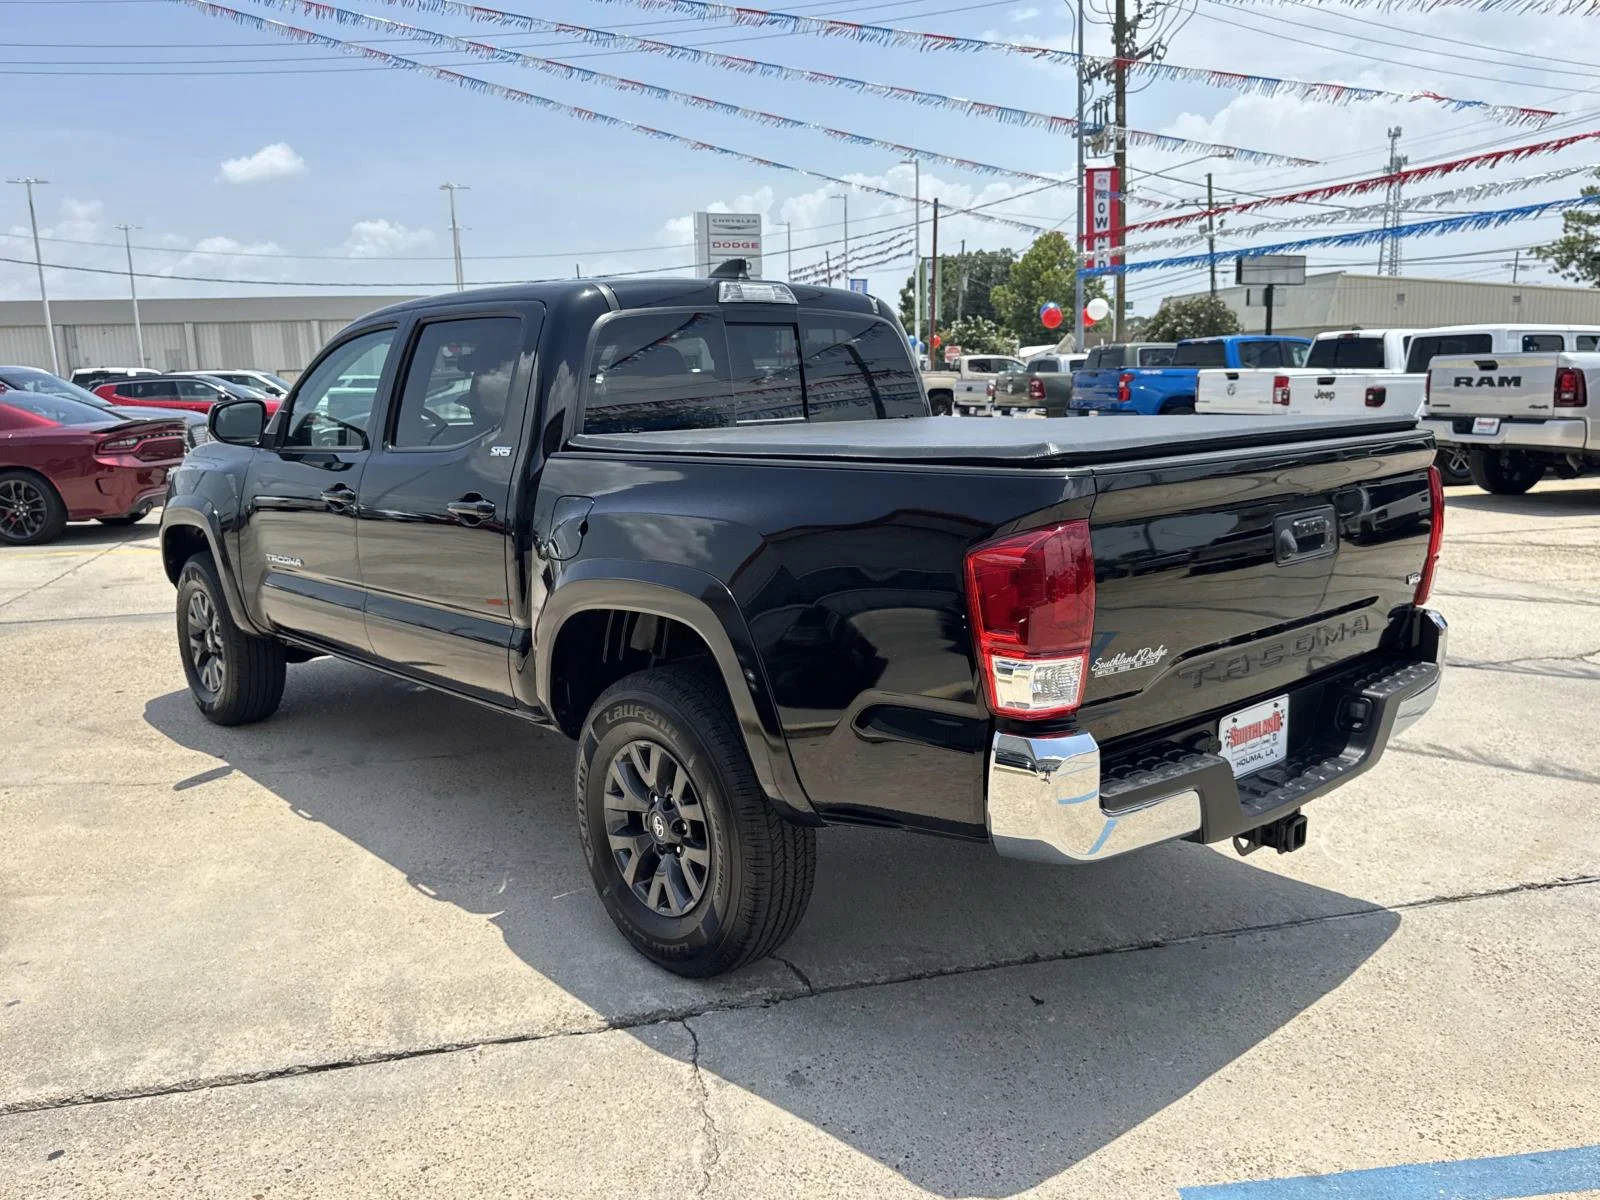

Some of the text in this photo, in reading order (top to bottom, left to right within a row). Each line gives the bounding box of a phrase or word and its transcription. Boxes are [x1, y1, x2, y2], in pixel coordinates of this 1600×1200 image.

[712, 241, 760, 249] DODGE
[1453, 376, 1522, 388] RAM
[1314, 389, 1335, 401] Jeep
[265, 553, 303, 568] TACOMA
[1091, 648, 1142, 672] Southland
[1140, 644, 1168, 664] Dodge
[1177, 614, 1370, 689] TACOMA
[1231, 711, 1281, 748] SOUTHLAND
[1236, 748, 1275, 768] HOUMA, LA
